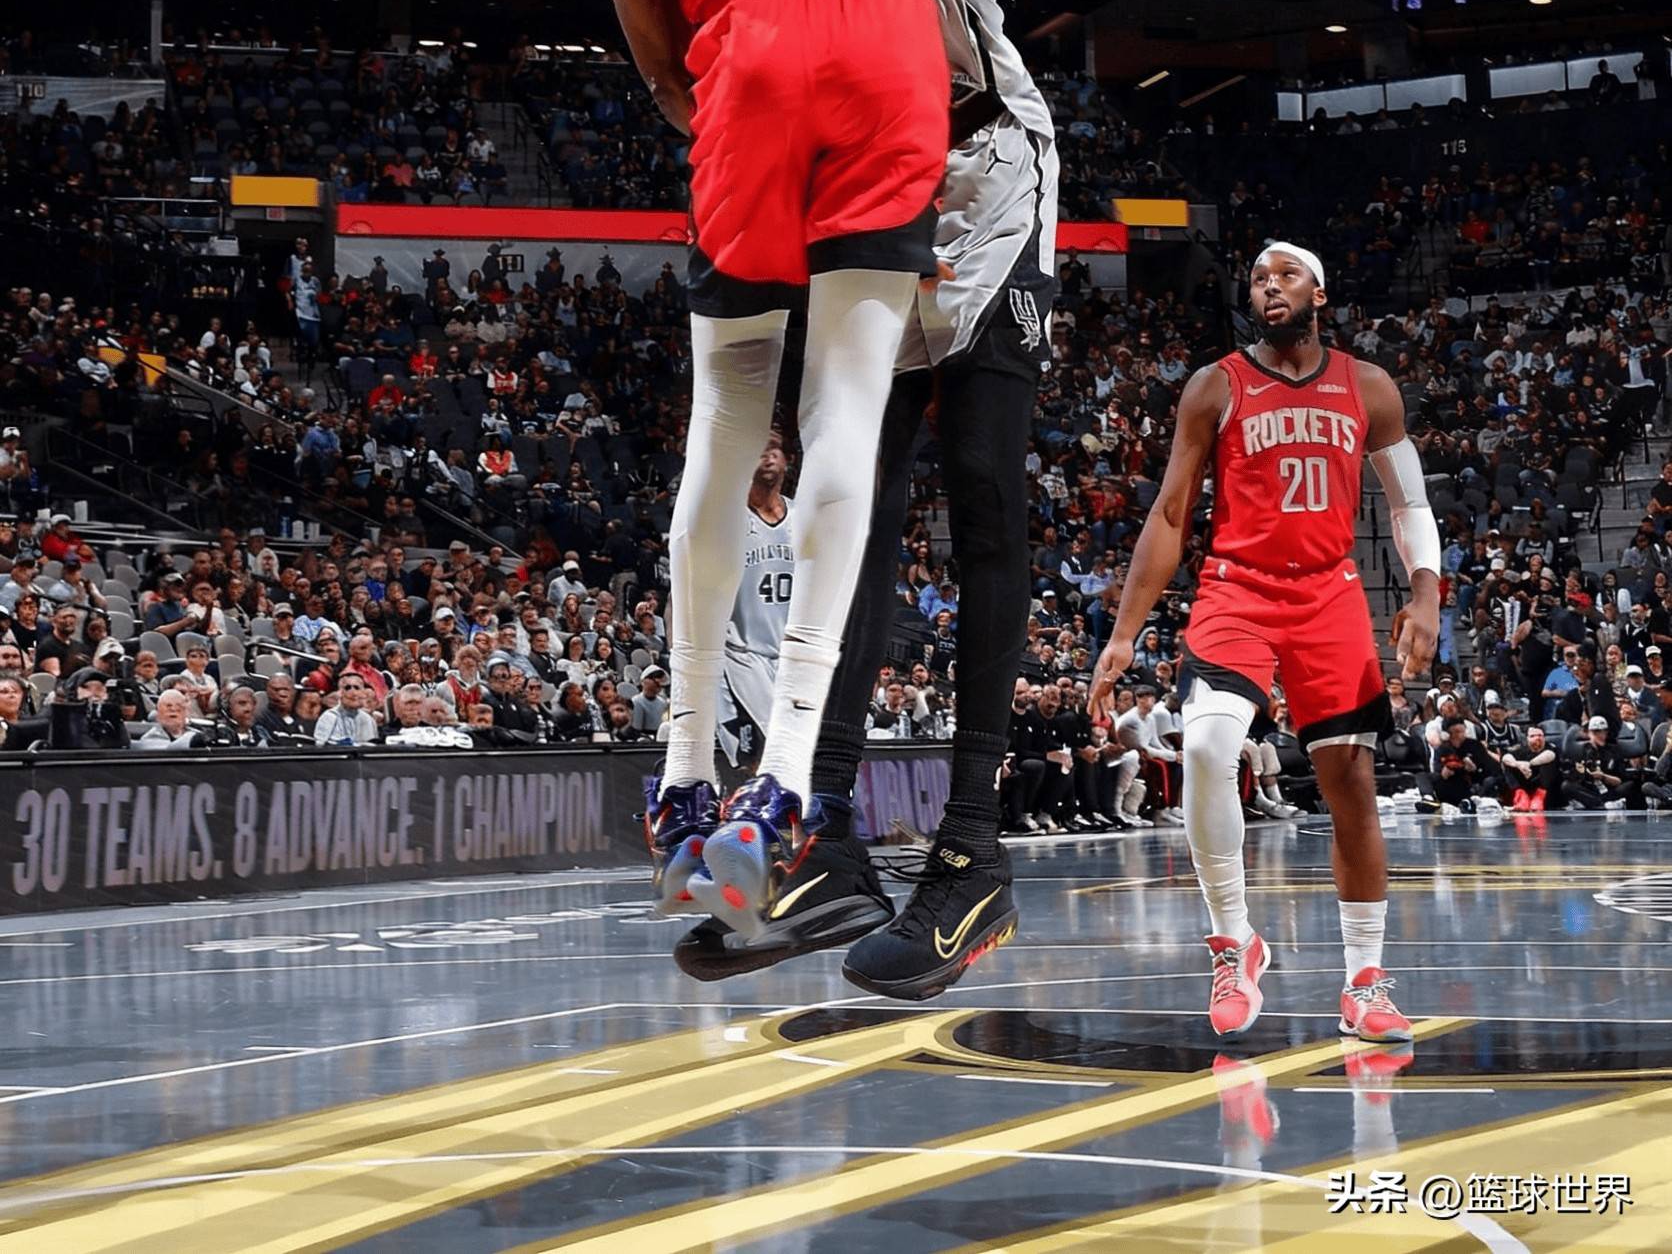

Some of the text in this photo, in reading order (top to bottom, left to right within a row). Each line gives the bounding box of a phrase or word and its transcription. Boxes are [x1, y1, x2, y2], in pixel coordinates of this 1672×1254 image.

[1241, 406, 1360, 458] ROCKETS
[1279, 456, 1330, 514] 20
[757, 571, 794, 605] 40
[13, 770, 611, 896] 30 TEAMS. 8 ADVANCE. 1 CHAMPION.
